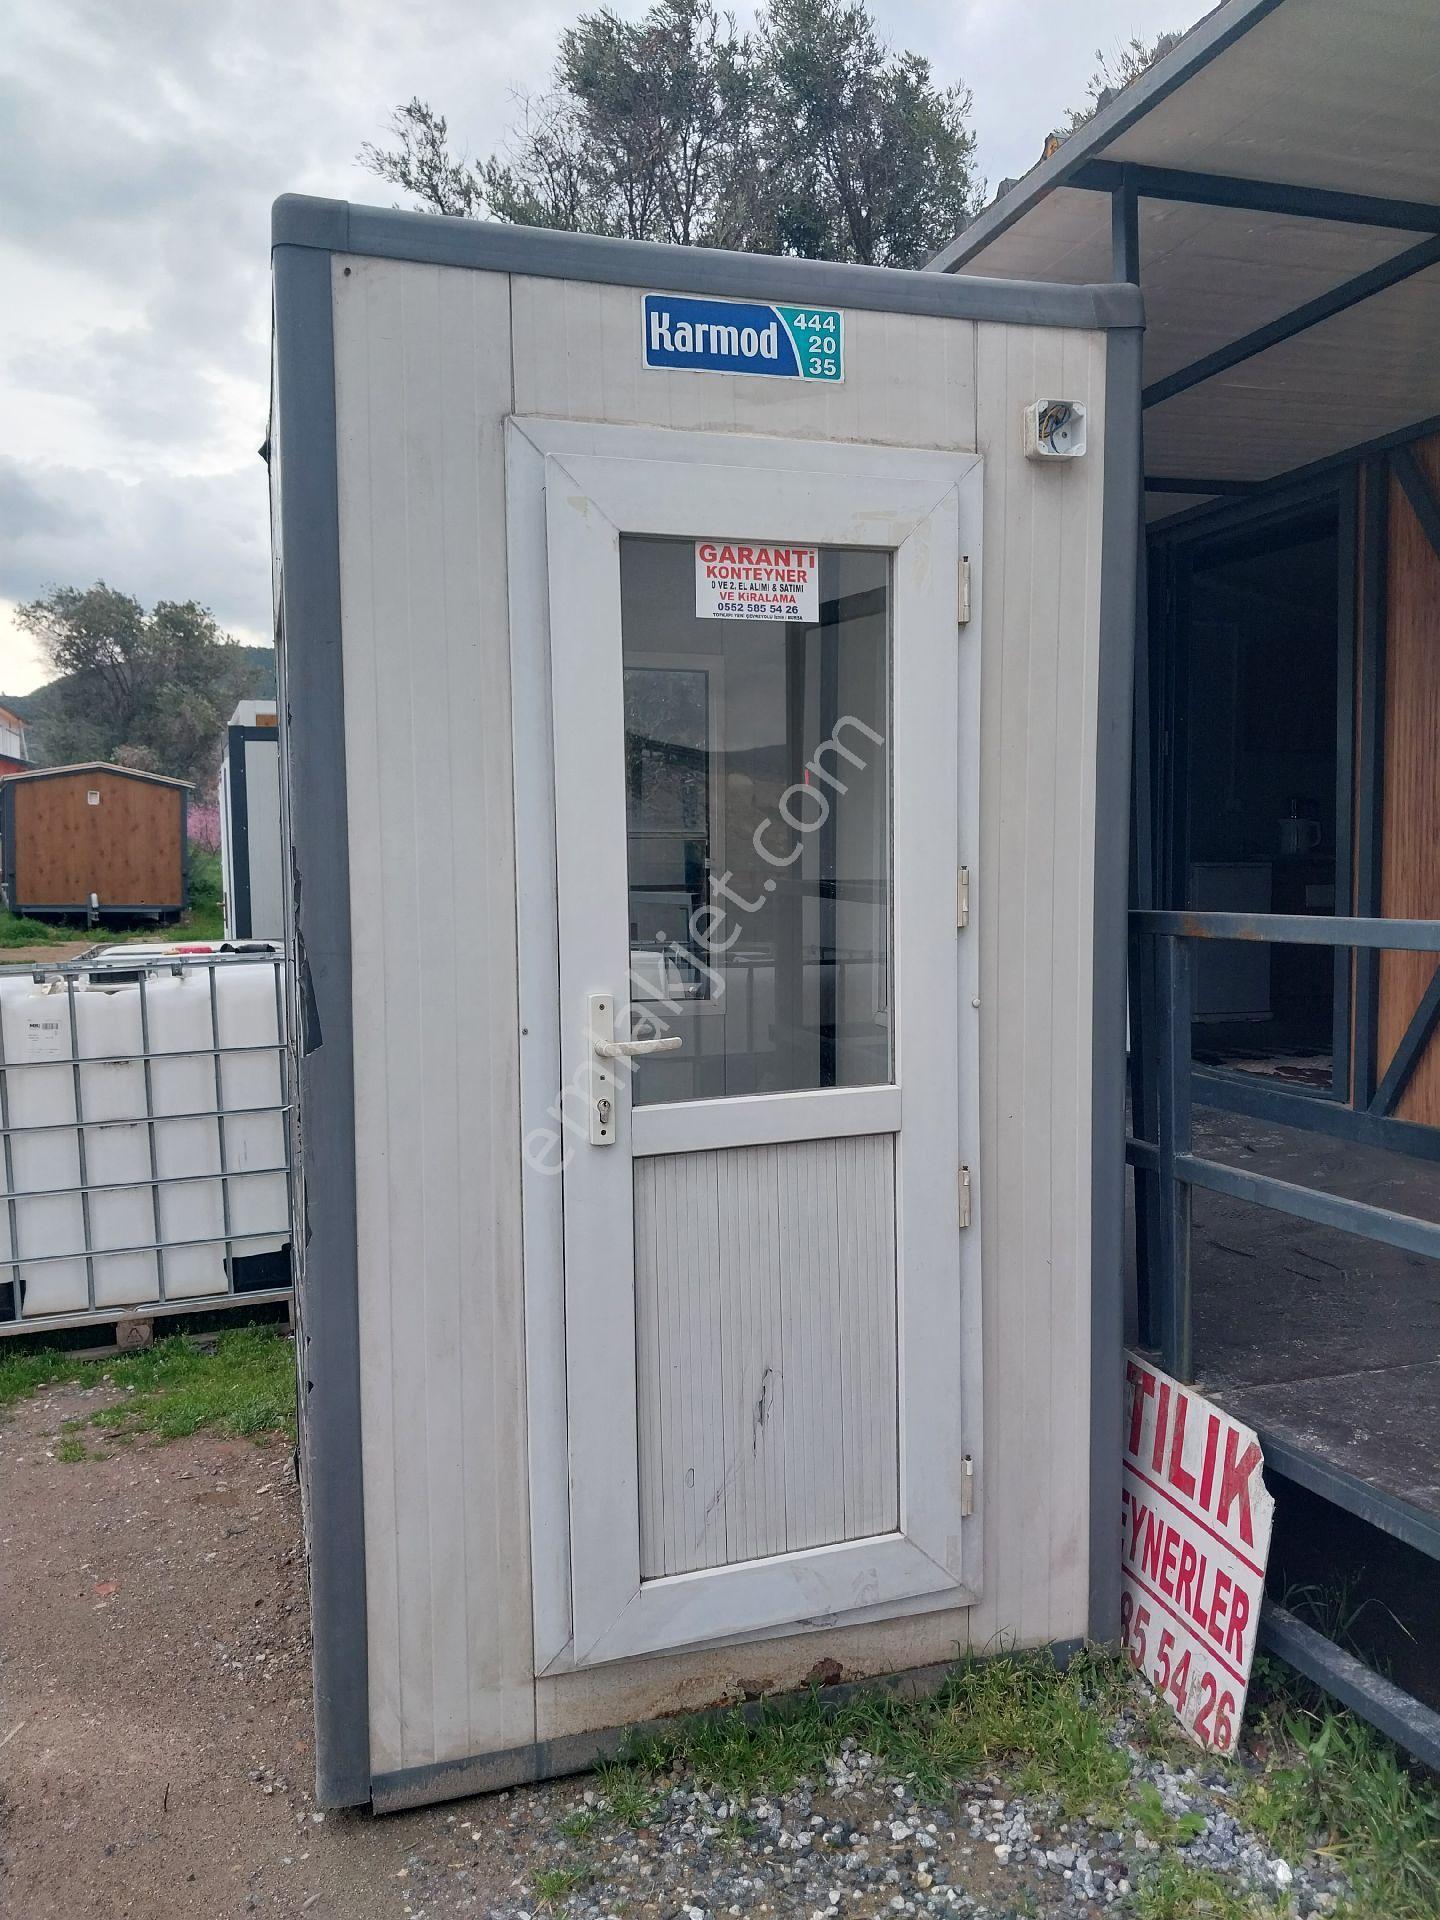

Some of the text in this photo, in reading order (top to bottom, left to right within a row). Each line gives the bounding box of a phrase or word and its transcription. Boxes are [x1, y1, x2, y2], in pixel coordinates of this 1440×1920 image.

[793, 313, 836, 333] 444
[650, 311, 778, 359] Karmod
[808, 335, 836, 355] 20
[809, 357, 837, 376] 35
[706, 565, 808, 583] KONTEYNER
[711, 580, 716, 589] 0
[718, 581, 728, 590] VE
[738, 582, 748, 591] EL
[749, 582, 770, 592] ALIMI
[772, 583, 777, 592] &
[779, 583, 804, 593] SATIMI
[719, 591, 734, 601] VE
[717, 602, 799, 614] 0552 585 54 26
[1127, 1360, 1263, 1549] TILIK
[1153, 1627, 1192, 1715] 54
[1193, 1671, 1236, 1751] 26
